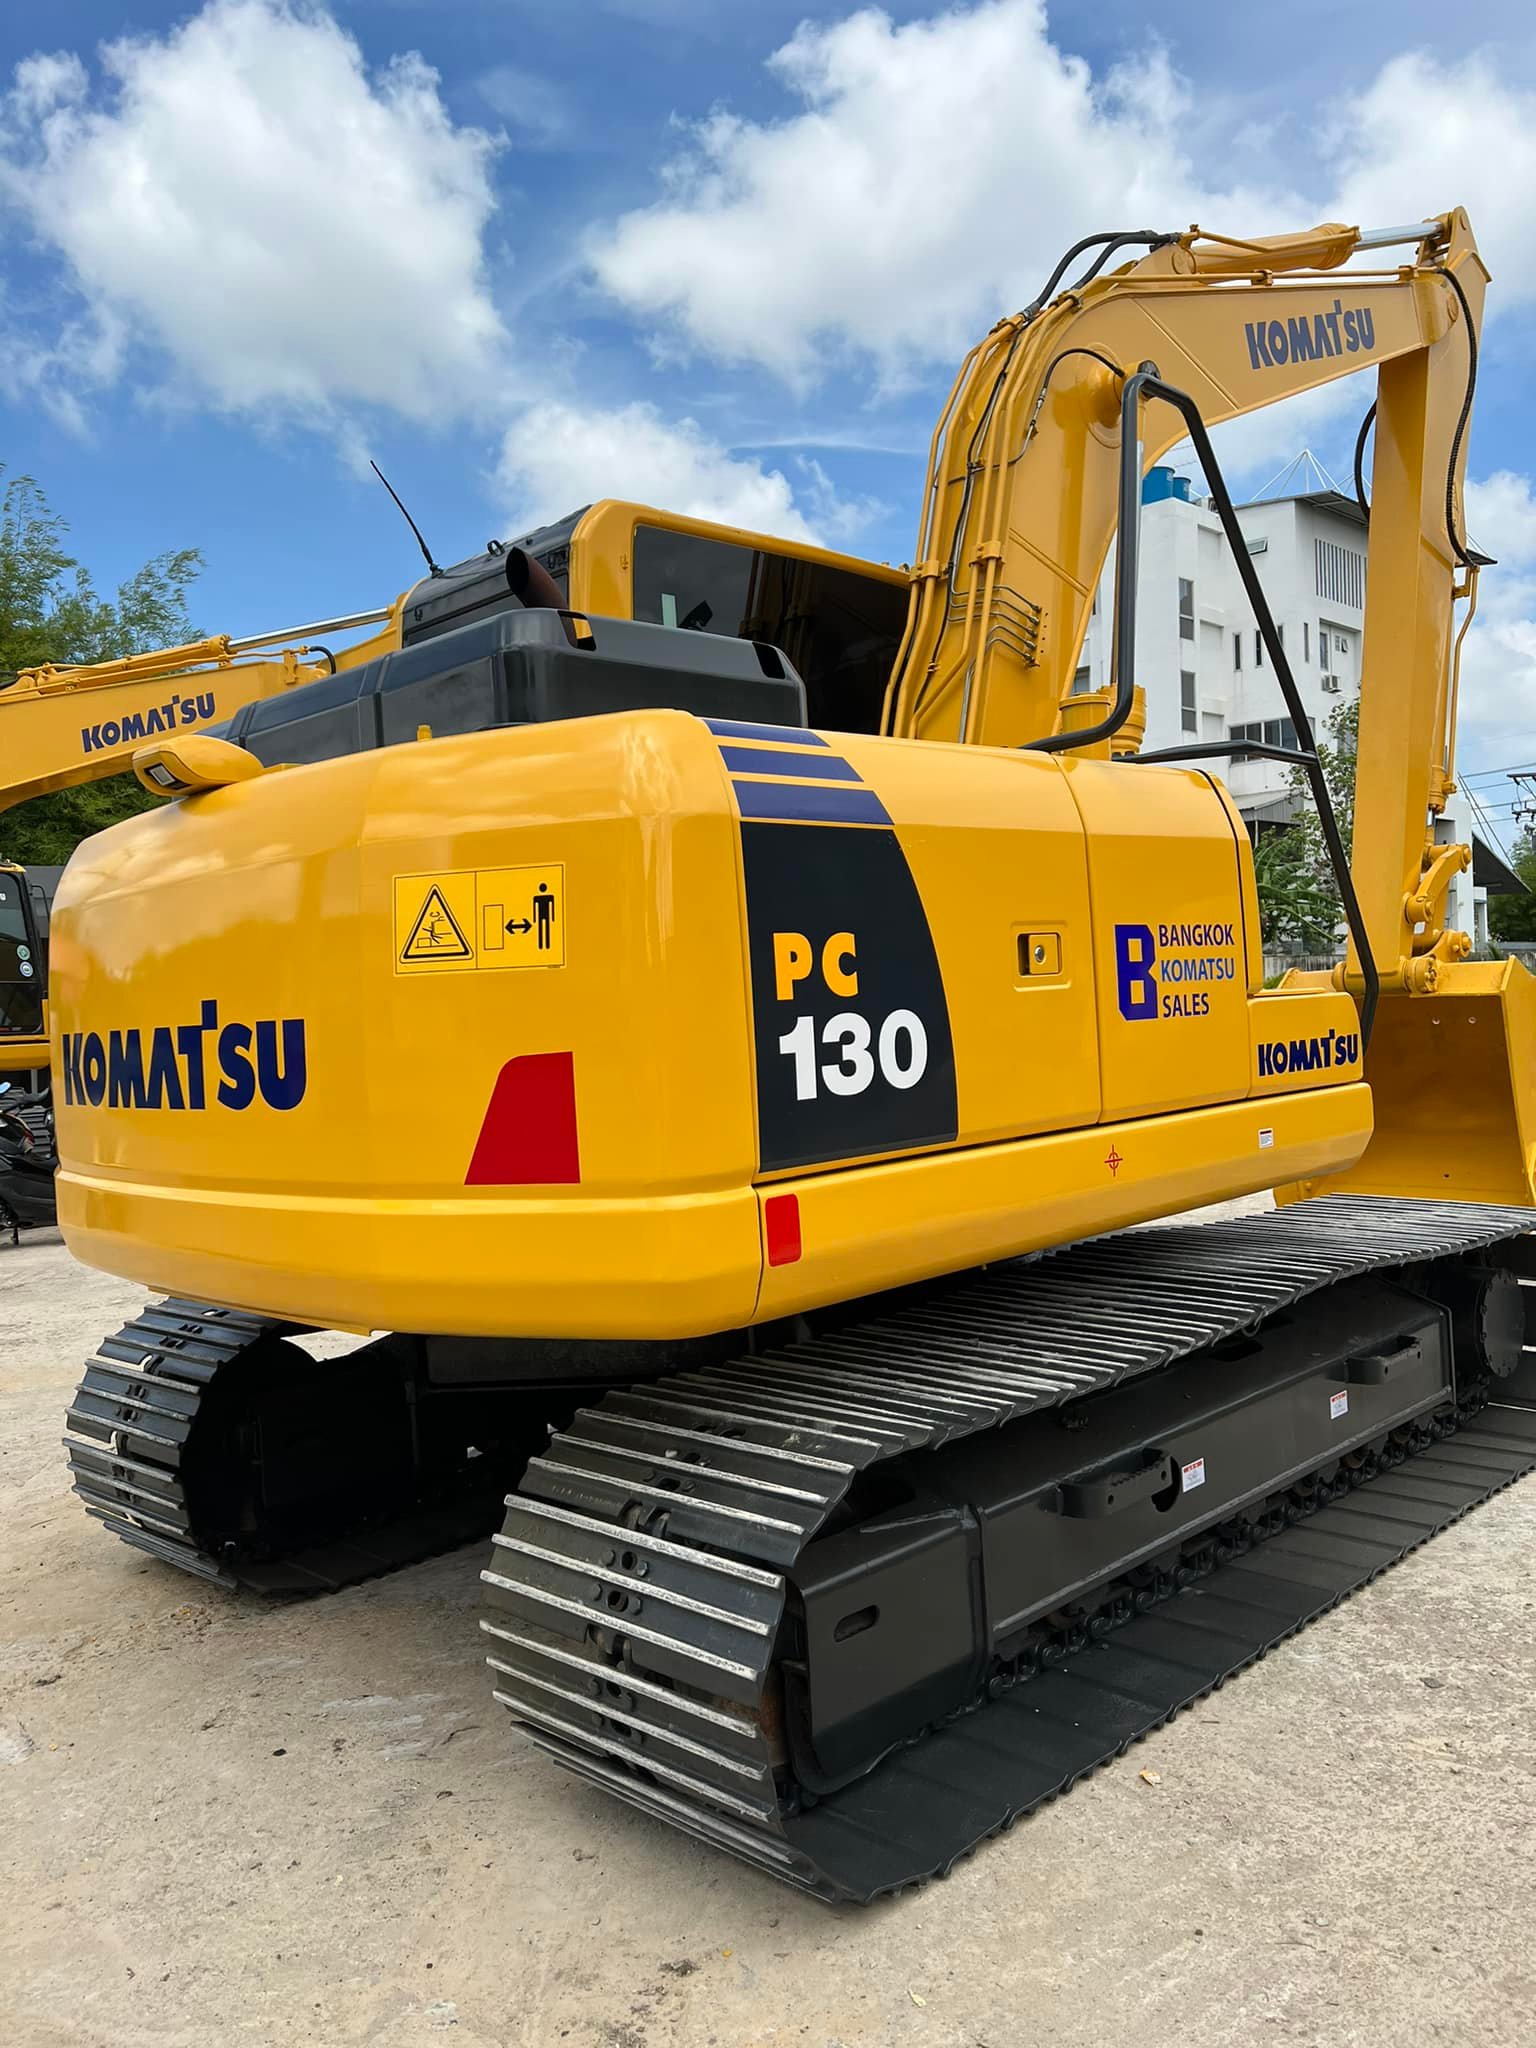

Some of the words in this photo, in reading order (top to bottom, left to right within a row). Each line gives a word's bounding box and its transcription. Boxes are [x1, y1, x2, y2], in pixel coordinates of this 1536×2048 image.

[1245, 299, 1375, 369] KOMATSU
[82, 692, 214, 753] KOMATSU
[1159, 924, 1234, 947] BANGKOK
[773, 932, 858, 1001] PC
[1161, 957, 1235, 982] KOMATSU
[1162, 992, 1209, 1018] SALES
[62, 999, 307, 1111] KOMATSU
[778, 1009, 928, 1101] 130
[1257, 1029, 1358, 1077] KOMATSU
